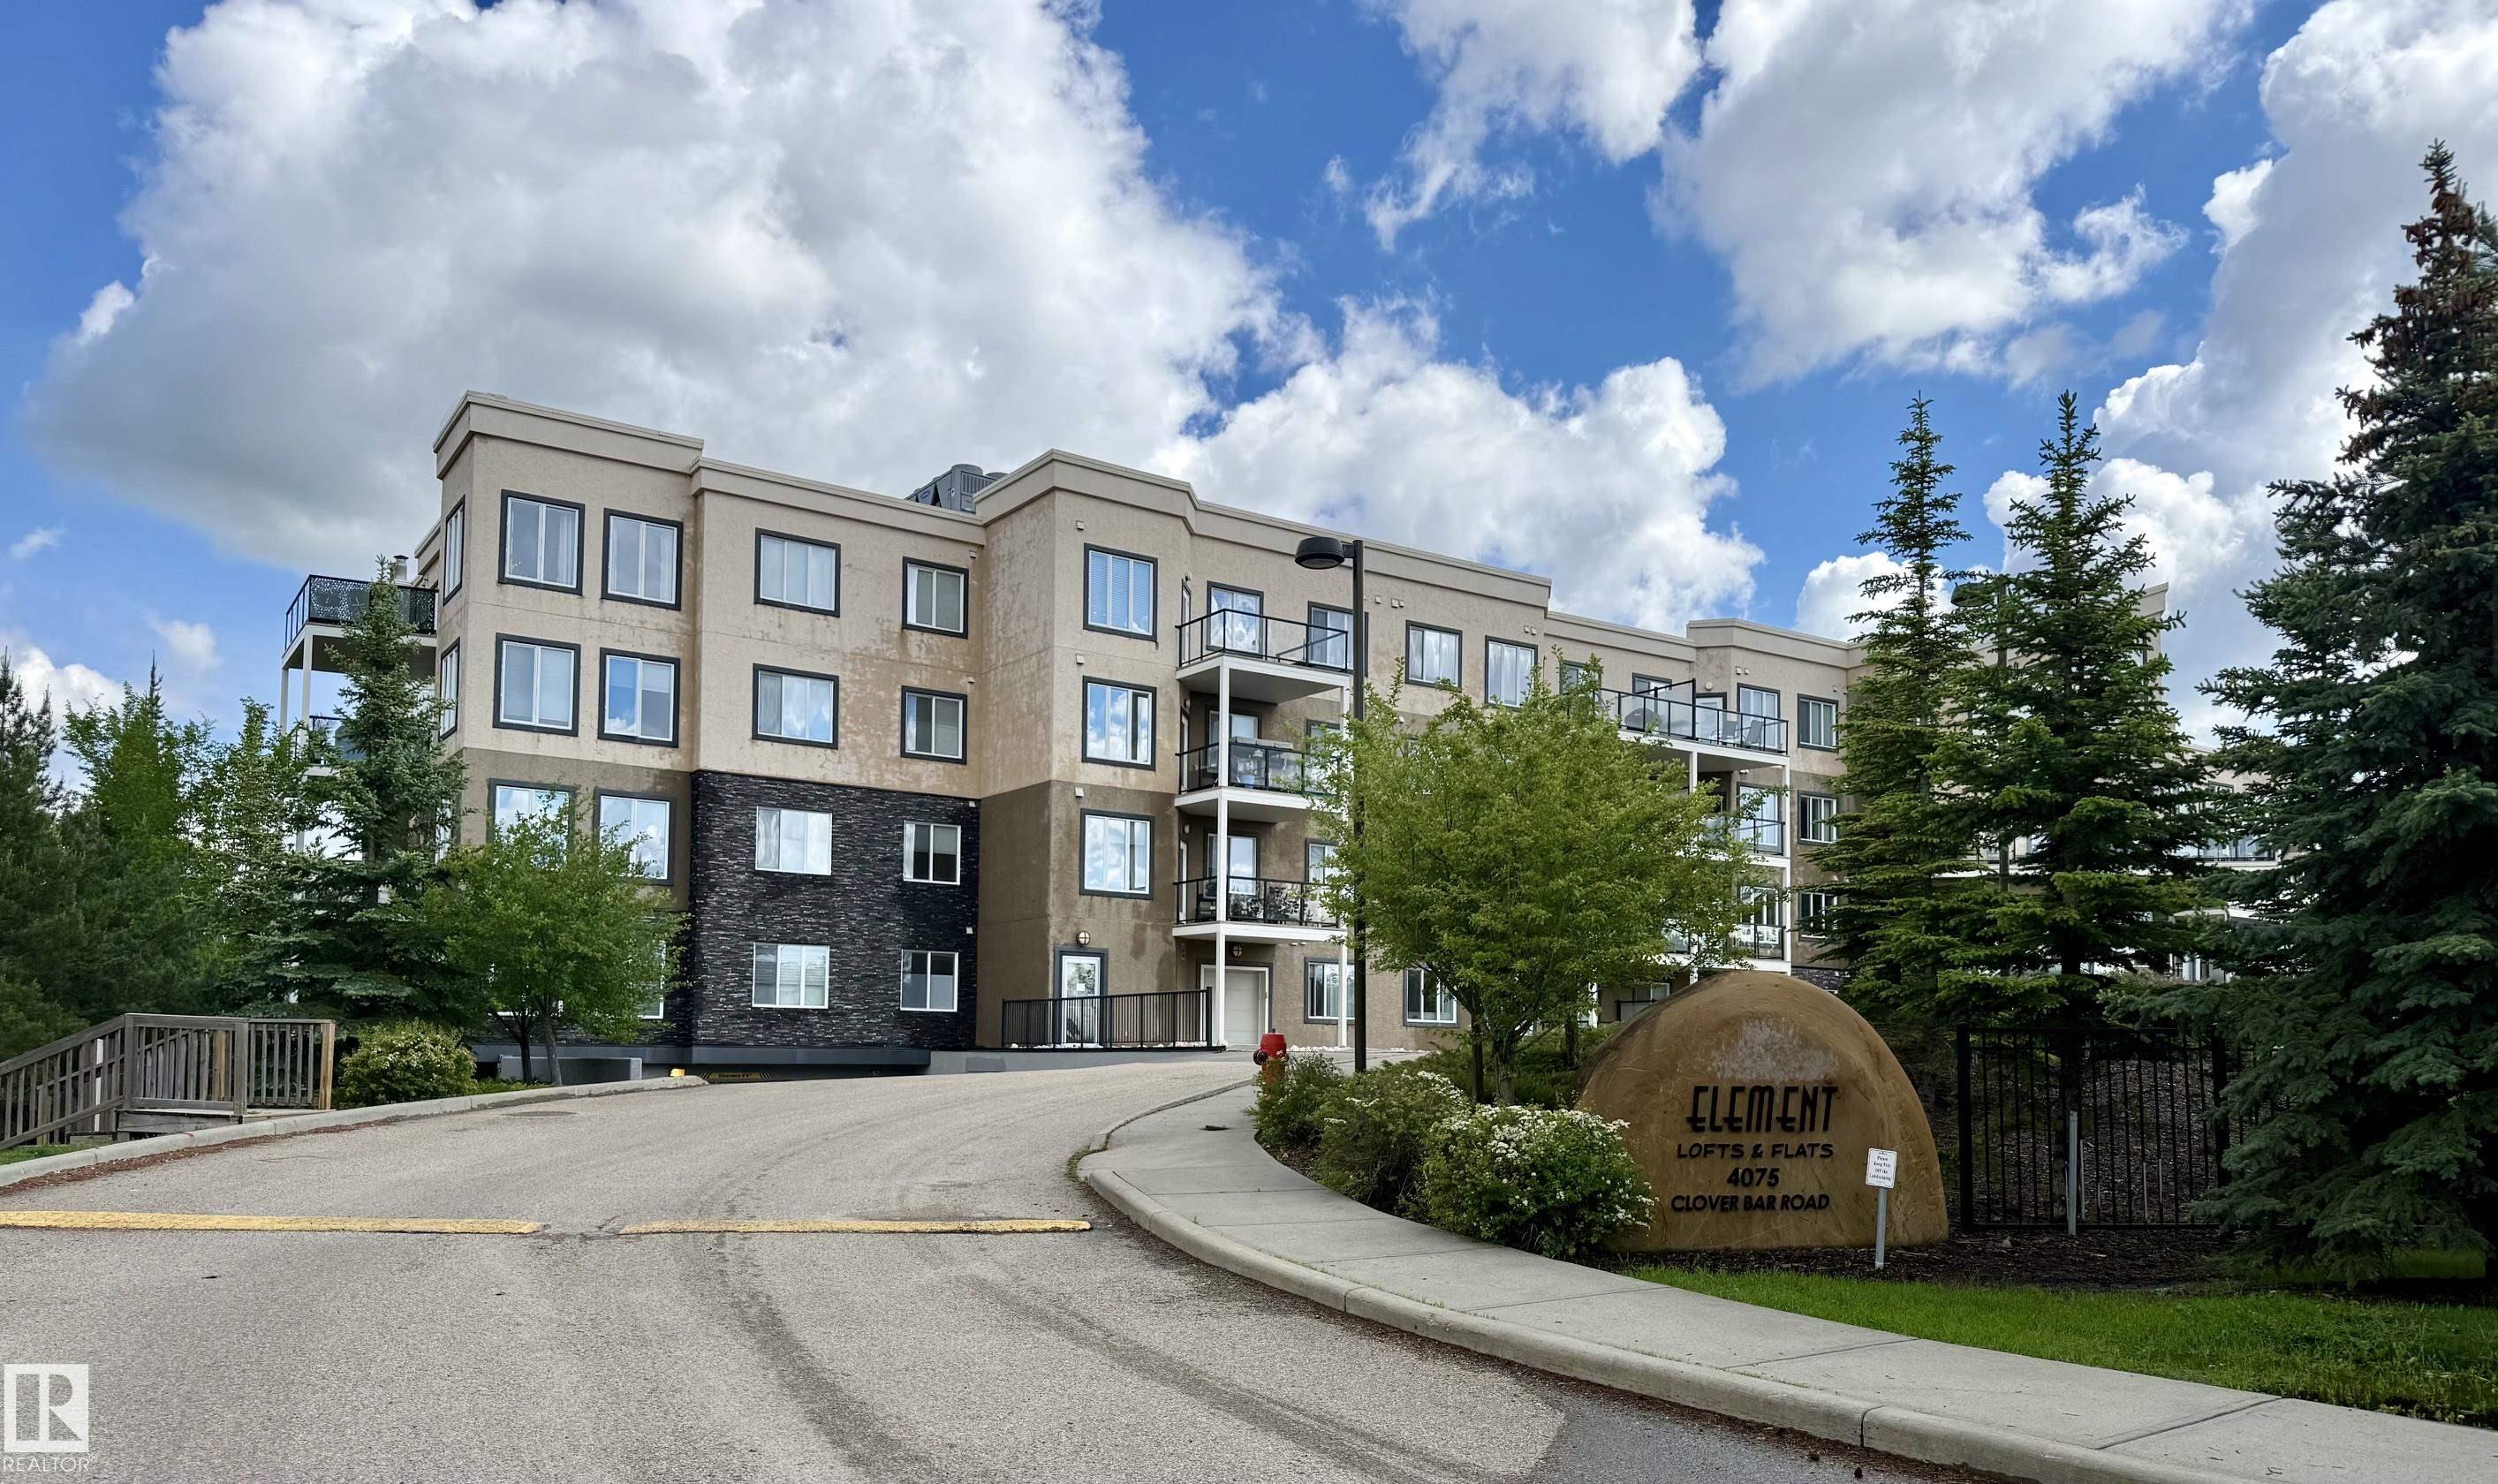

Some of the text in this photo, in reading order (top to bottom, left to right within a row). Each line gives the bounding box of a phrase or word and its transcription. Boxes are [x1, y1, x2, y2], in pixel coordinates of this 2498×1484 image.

[1686, 1085, 1838, 1132] ELEMENT
[1677, 1143, 1835, 1159] LOFTS & FLATS
[1727, 1168, 1780, 1187] 4075
[1671, 1193, 1829, 1212] CLOVER BAR ROAD
